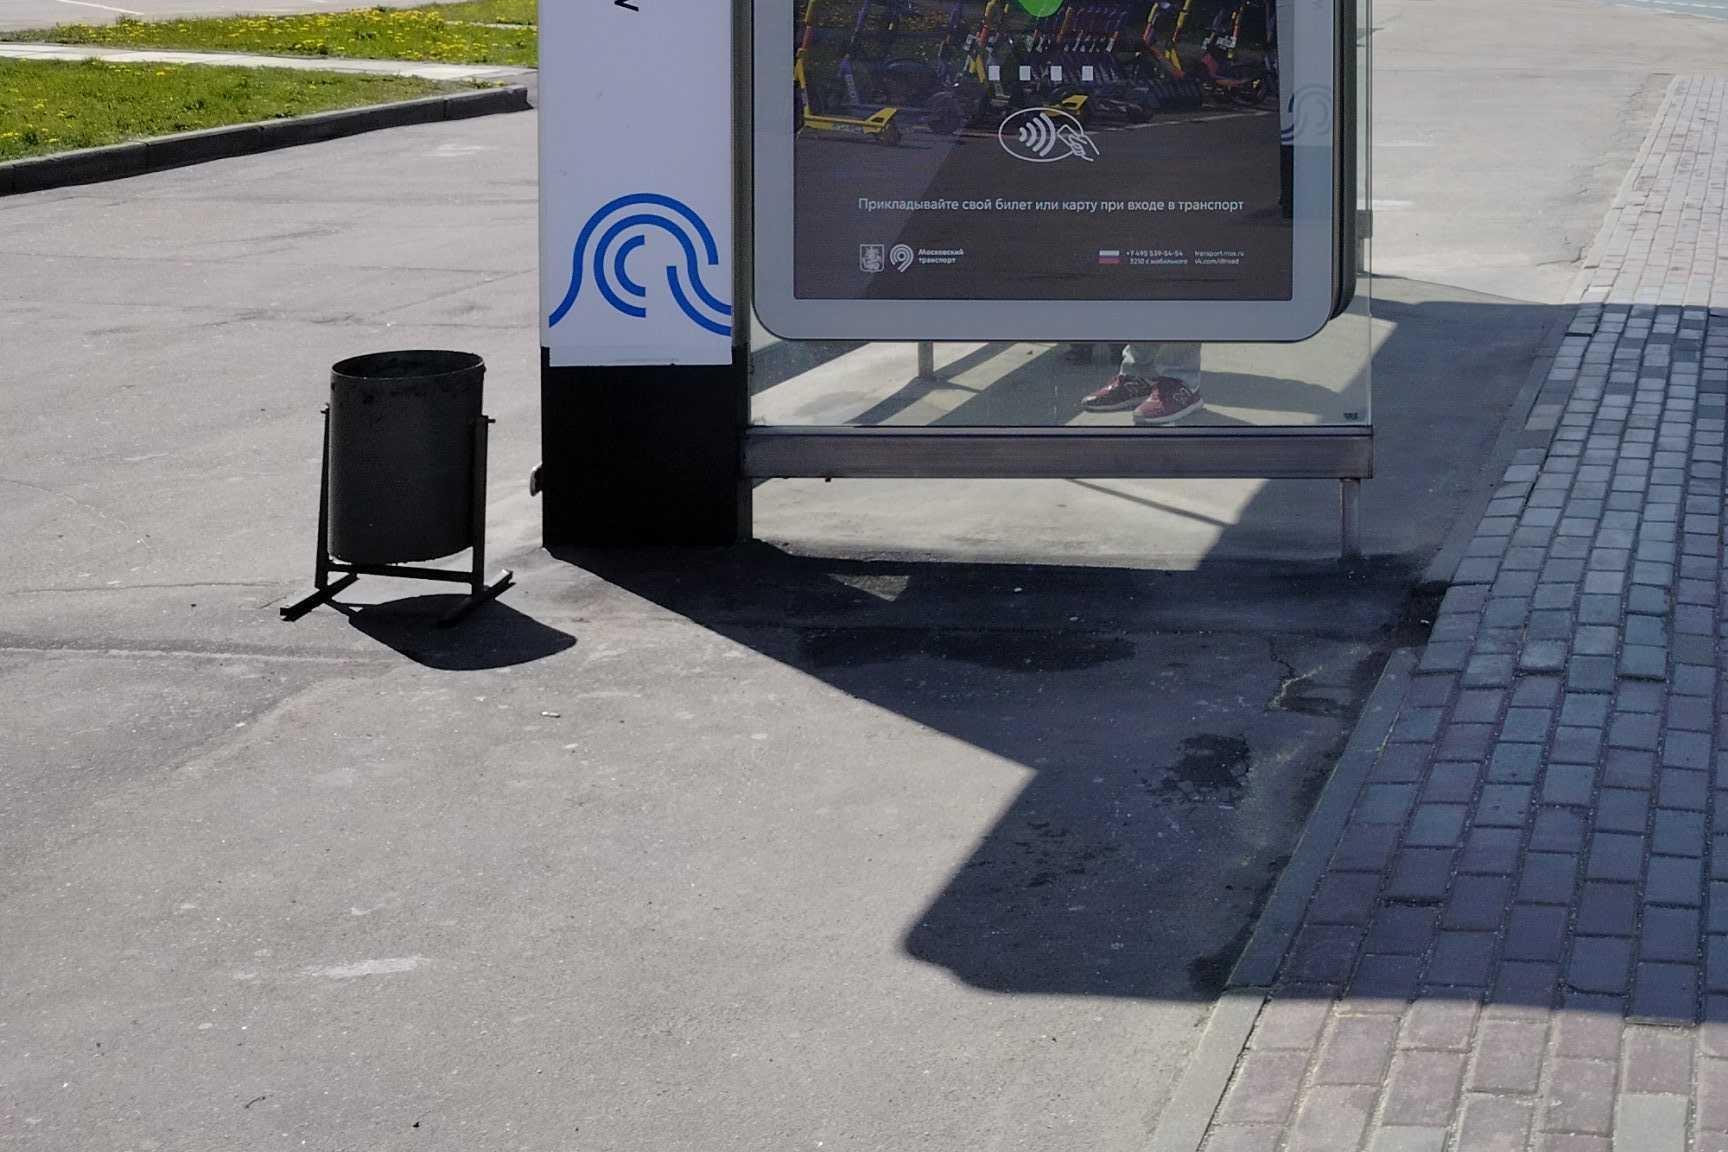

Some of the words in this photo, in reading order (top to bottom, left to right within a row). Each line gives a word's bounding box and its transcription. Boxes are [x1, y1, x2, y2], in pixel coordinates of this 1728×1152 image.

[858, 198, 959, 212] Прикладывайте
[962, 198, 992, 210] свой
[995, 198, 1032, 210] билет
[1035, 201, 1058, 210] или
[1062, 201, 1097, 213] карту
[1101, 201, 1124, 212] при
[1128, 201, 1165, 212] входе
[1168, 201, 1175, 210] в
[1178, 201, 1244, 212] транспорт
